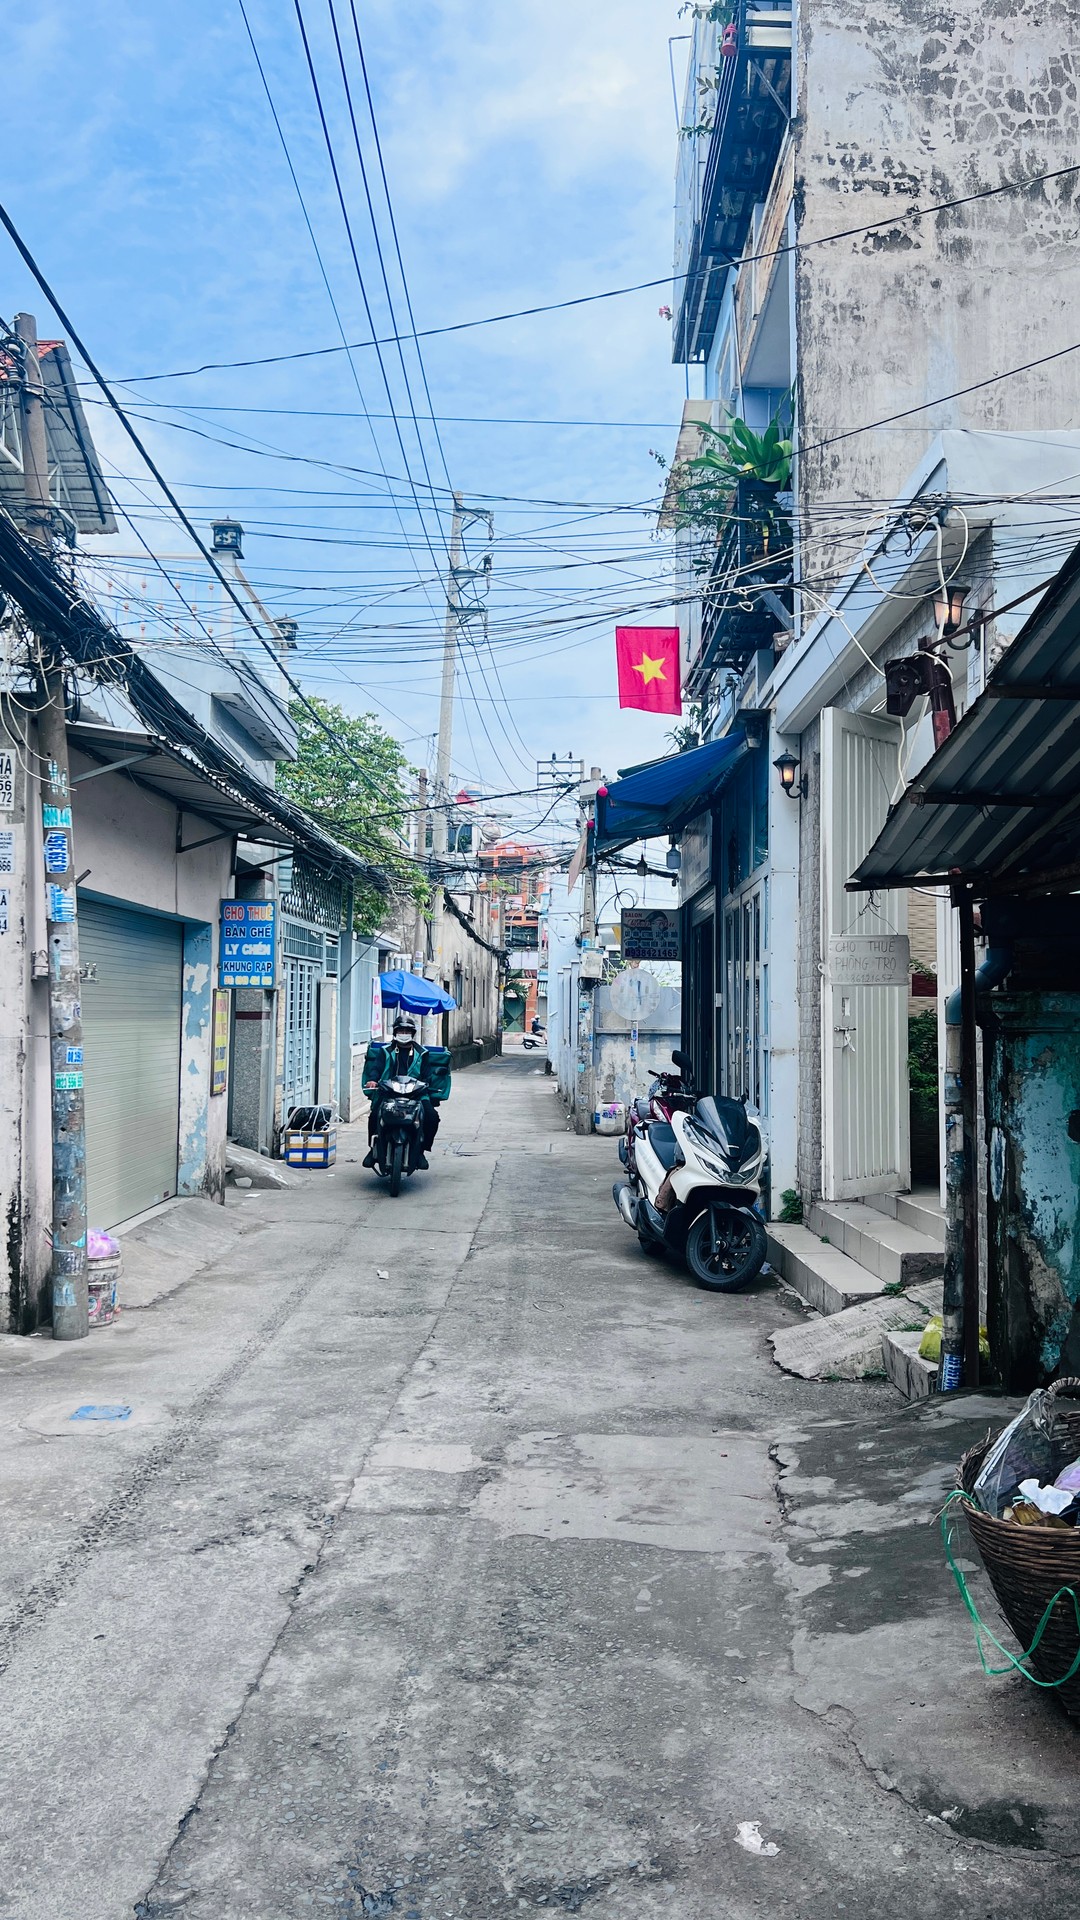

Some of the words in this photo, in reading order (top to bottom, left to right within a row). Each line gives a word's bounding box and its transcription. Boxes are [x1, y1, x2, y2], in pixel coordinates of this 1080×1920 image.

[224, 905, 245, 921] CHO
[247, 902, 274, 921] THUÊ
[225, 923, 247, 938] BÀN
[250, 923, 273, 938] GHẾ
[225, 943, 240, 955] LY
[835, 941, 856, 953] CHO
[867, 936, 896, 953] THUÊ
[625, 948, 678, 958] 0938421465
[223, 961, 253, 973] KHUNG
[875, 956, 897, 974] TRỌ
